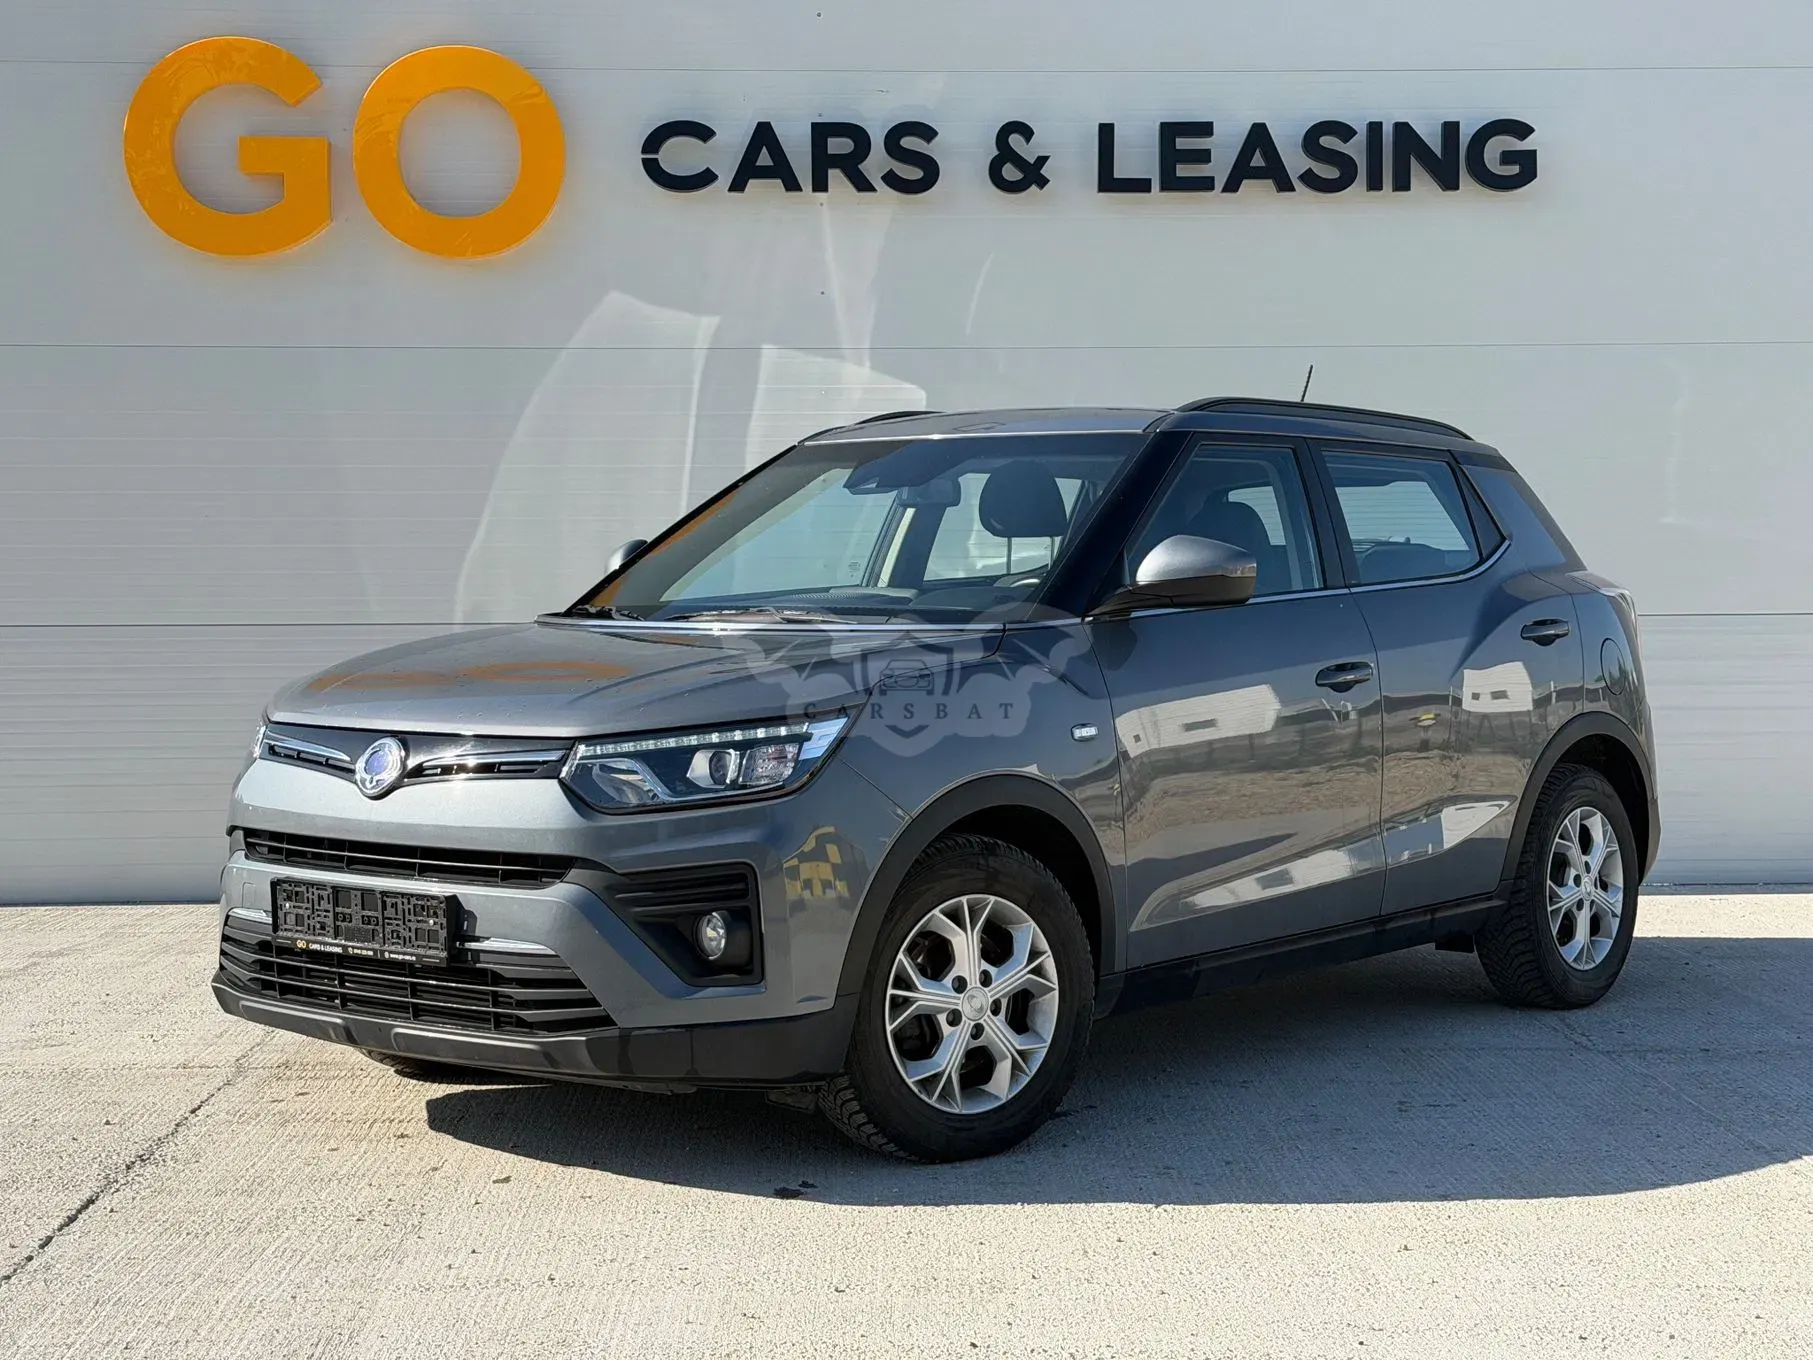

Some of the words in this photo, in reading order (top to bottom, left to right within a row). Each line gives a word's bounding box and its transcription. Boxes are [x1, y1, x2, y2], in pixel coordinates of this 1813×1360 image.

[123, 36, 565, 259] GO
[641, 119, 939, 194] CARS
[988, 120, 1051, 195] &
[1097, 118, 1538, 194] LEASING
[296, 940, 307, 949] GO
